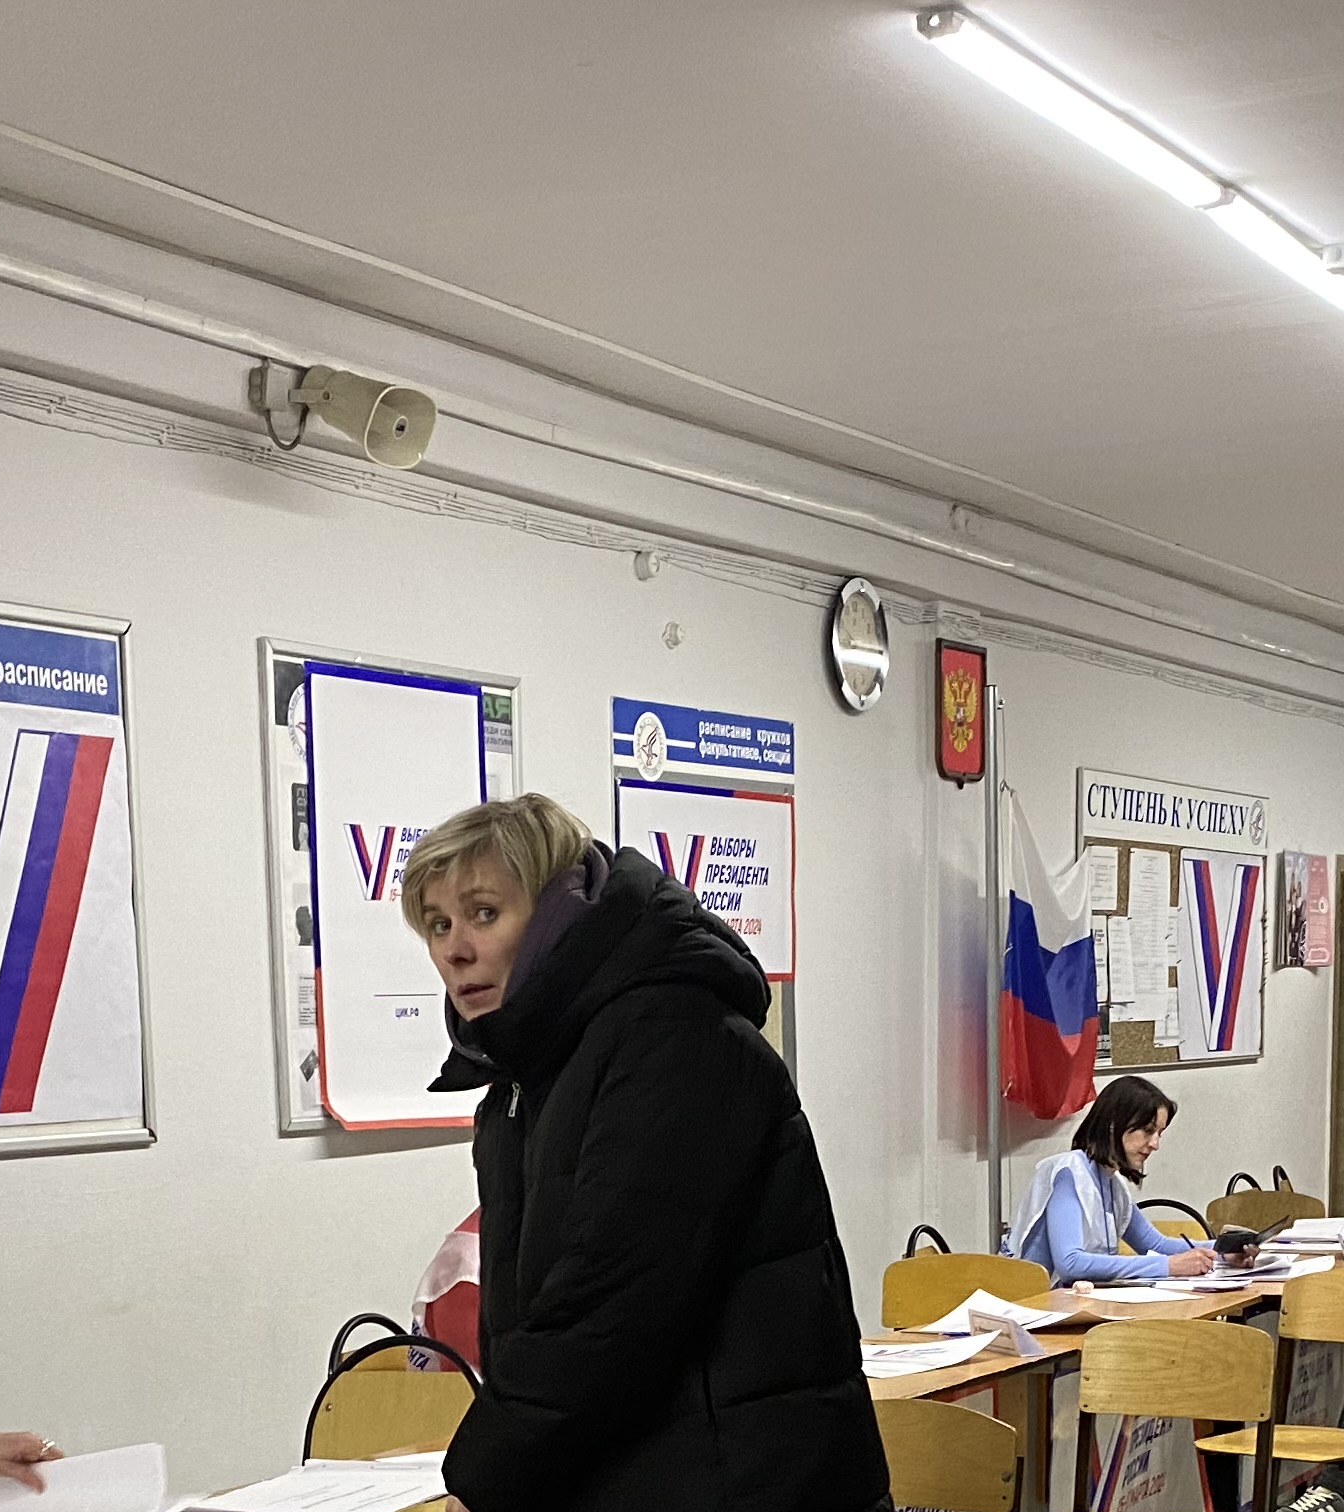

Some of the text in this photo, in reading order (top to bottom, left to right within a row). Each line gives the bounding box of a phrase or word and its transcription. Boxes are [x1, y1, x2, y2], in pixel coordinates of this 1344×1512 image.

[699, 721, 751, 740] расписание
[1087, 783, 1167, 825] СТУПЕНЬ
[1171, 796, 1183, 828] К
[1187, 798, 1250, 836] УСПЕХУ
[400, 827, 429, 842] ВЫБ
[710, 836, 757, 858] ВЫБОРЫ
[705, 864, 769, 888] ПРЕЗИДЕНТА
[701, 891, 742, 911] РОССИИ
[724, 918, 742, 934] АРТА
